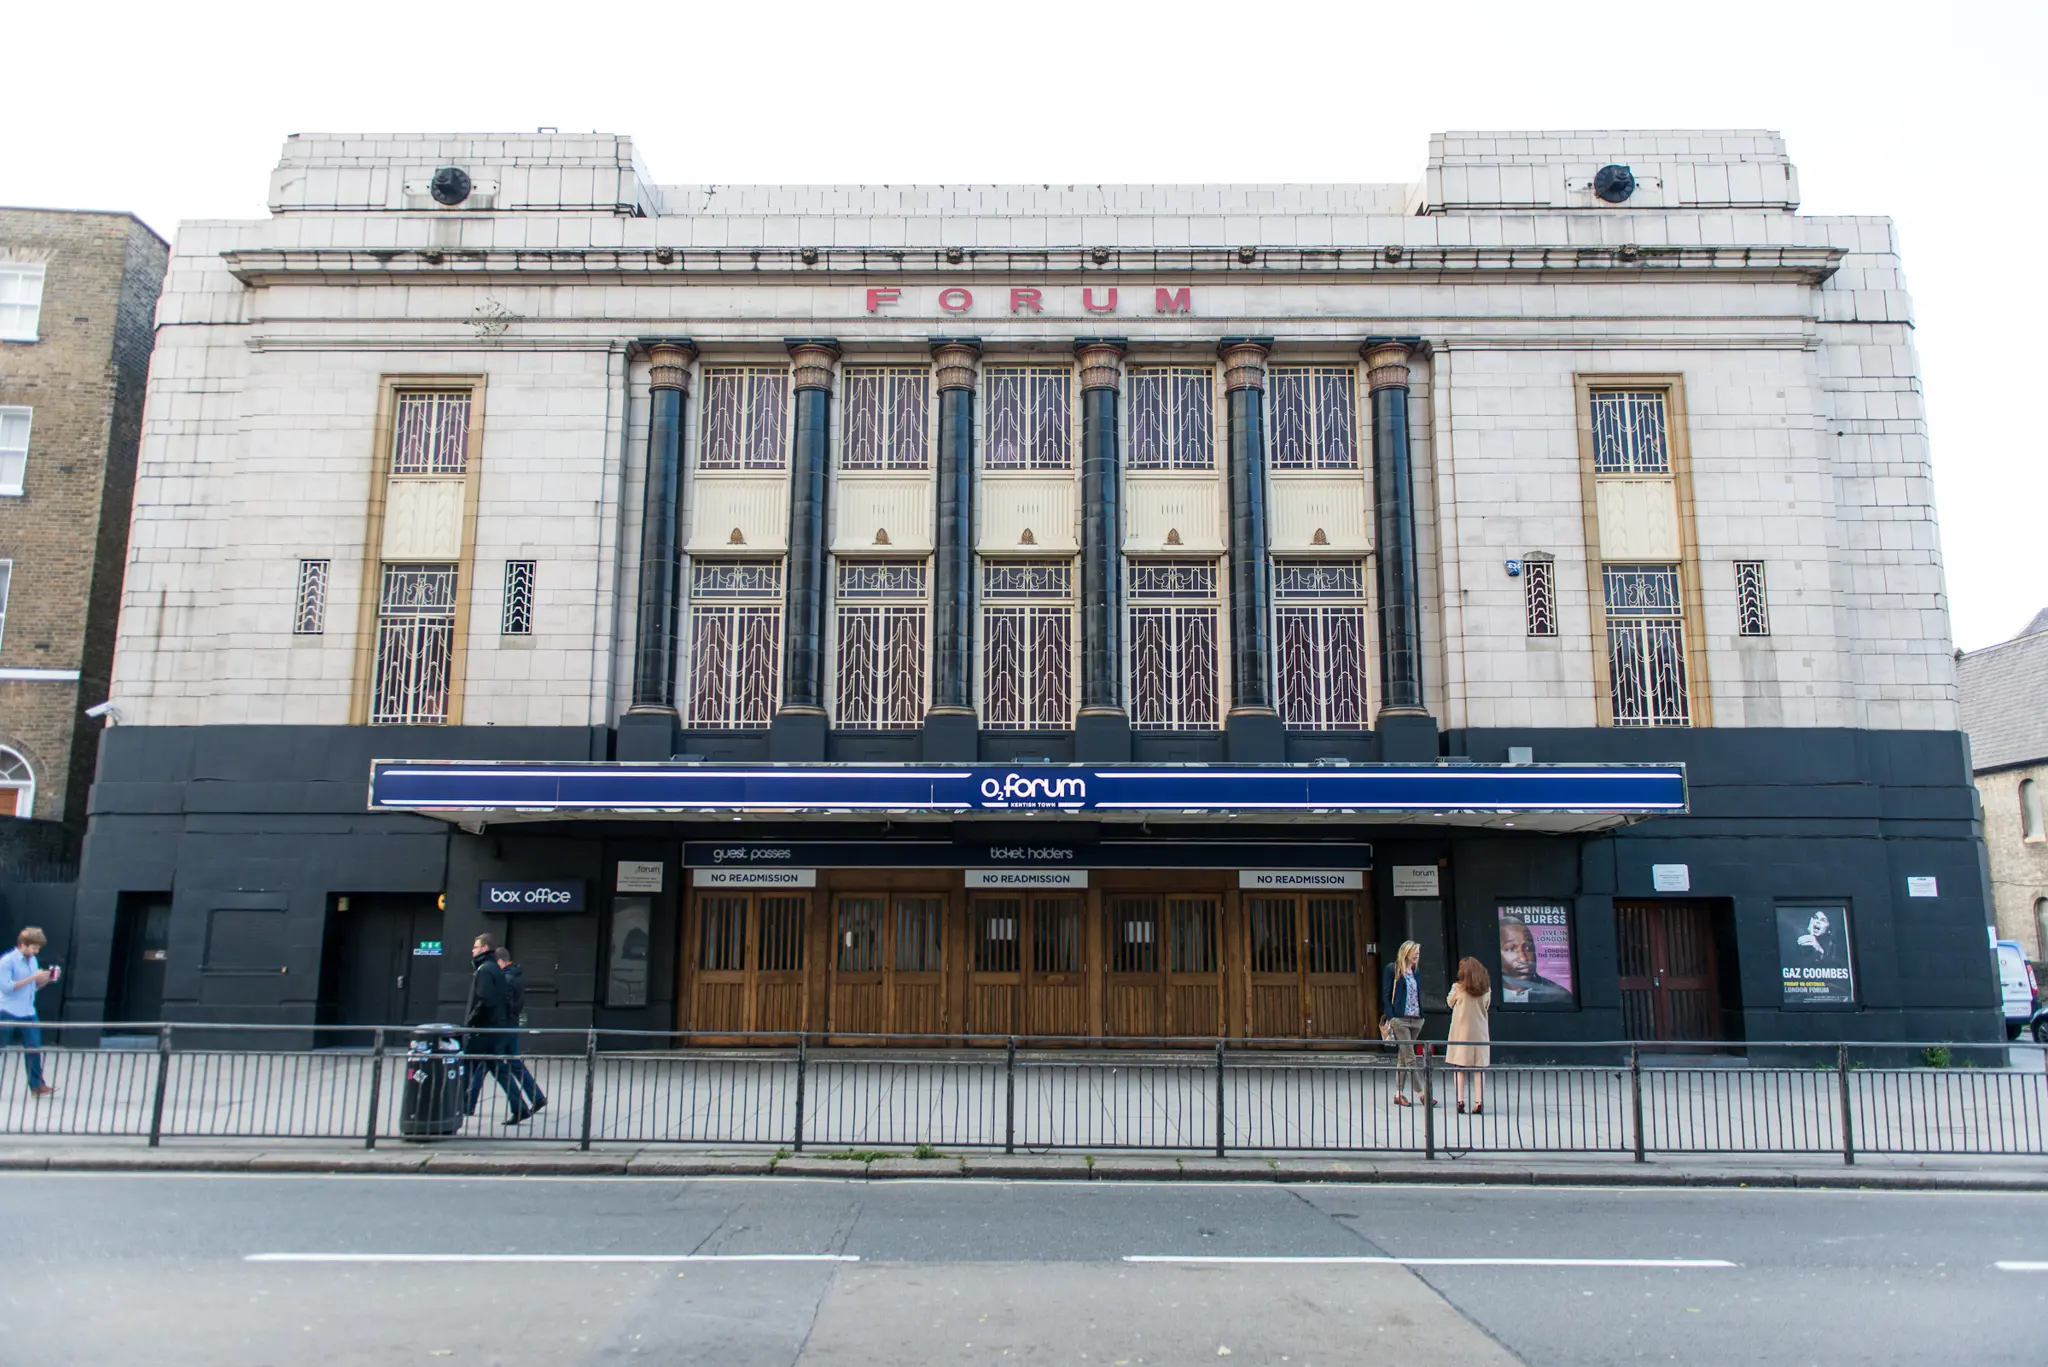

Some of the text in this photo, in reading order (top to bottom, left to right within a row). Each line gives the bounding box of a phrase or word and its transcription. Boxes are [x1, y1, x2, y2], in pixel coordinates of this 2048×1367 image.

[866, 288, 1190, 311] FORUM
[1004, 773, 1086, 798] forum
[713, 847, 791, 863] guest passes
[990, 847, 1073, 859] ticket holders
[711, 874, 798, 882] NO READMISSION
[982, 875, 1070, 883] NO READMISSION
[1257, 876, 1345, 884] NO READMISSION
[490, 888, 571, 903] box office
[1506, 906, 1566, 914] HANNIBAL
[1524, 915, 1566, 924] BURESS
[1783, 968, 1848, 979] GAZ COOMBES
